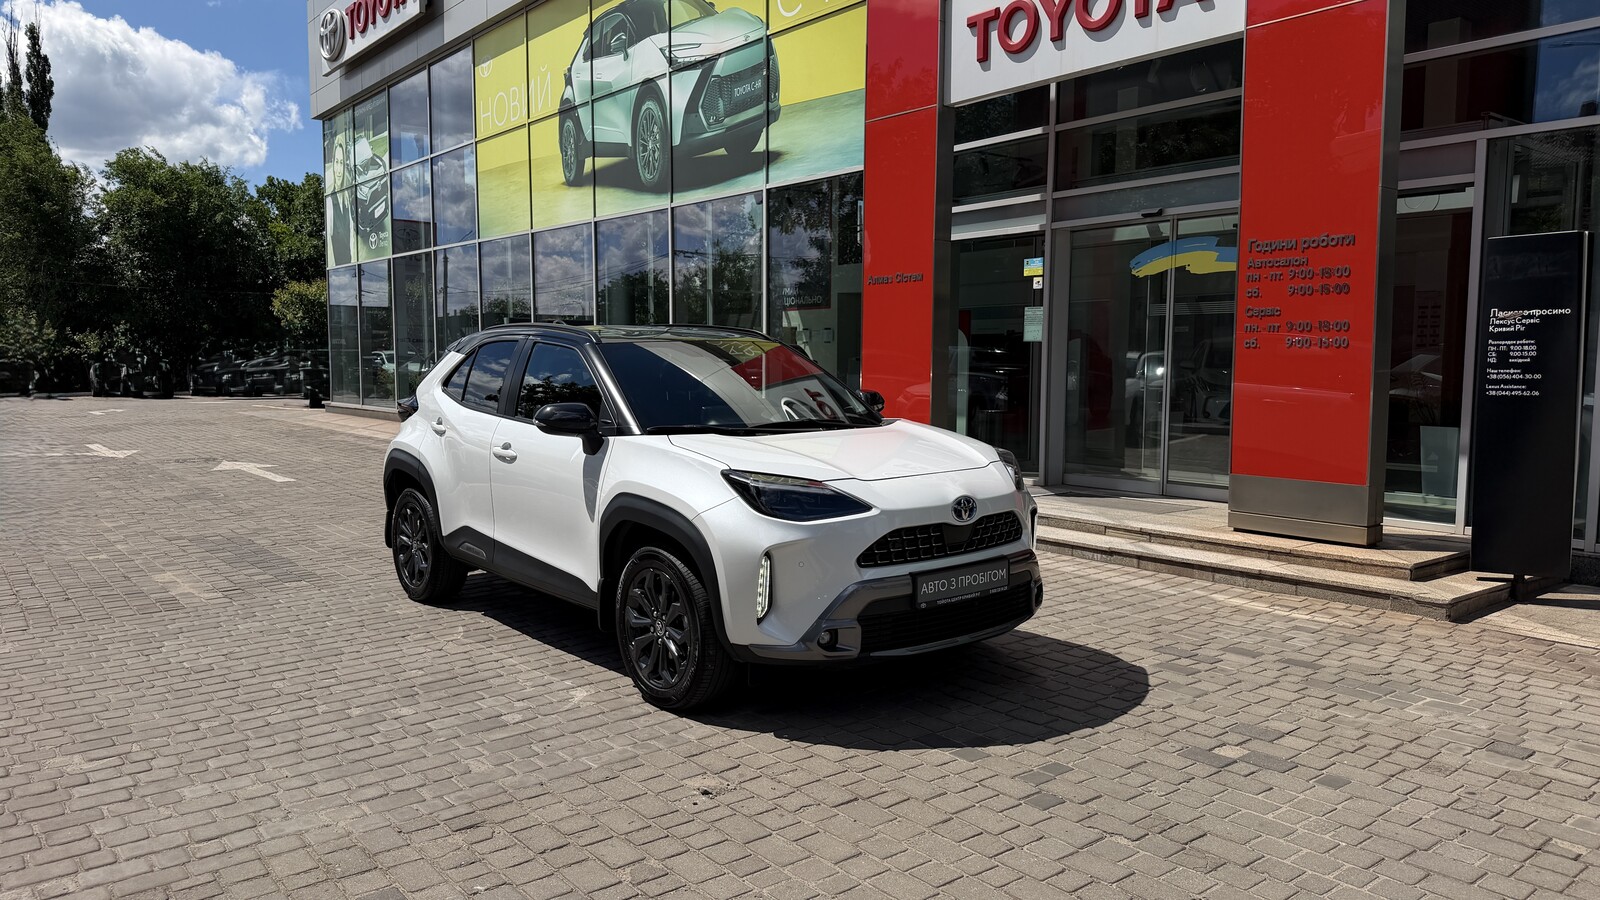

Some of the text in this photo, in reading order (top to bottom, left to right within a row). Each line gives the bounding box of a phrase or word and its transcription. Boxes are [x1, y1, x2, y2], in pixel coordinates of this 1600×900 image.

[480, 64, 552, 133] НОВИЙ
[1248, 232, 1356, 254] Години роботи
[1247, 256, 1308, 269] Автосалон
[867, 275, 893, 286] Алмаз
[1246, 286, 1262, 298] сб.
[1245, 305, 1281, 320] Сервіс
[1530, 308, 1571, 316] просимо
[1490, 317, 1515, 325] Лексус
[1243, 338, 1260, 349] сб.
[920, 579, 948, 595] АВТО
[958, 568, 1007, 588] ПРОБІГОМ
